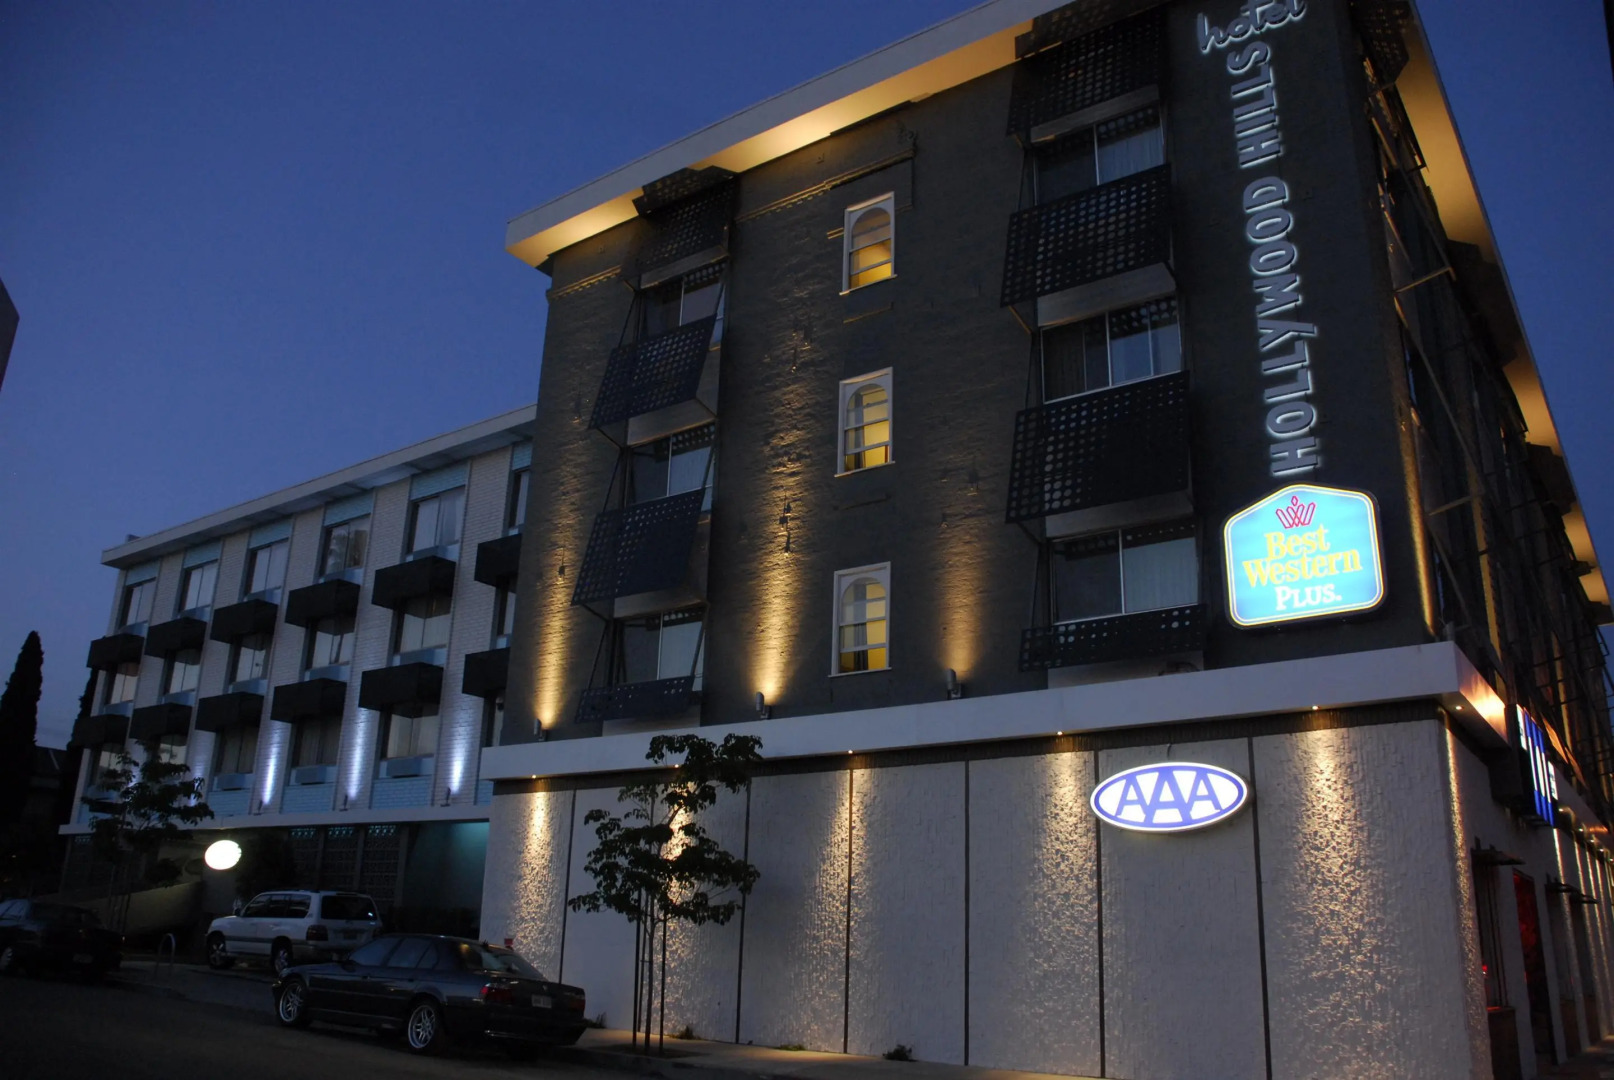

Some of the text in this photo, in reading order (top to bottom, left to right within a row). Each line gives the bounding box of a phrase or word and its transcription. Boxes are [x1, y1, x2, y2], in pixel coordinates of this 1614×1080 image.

[1227, 41, 1318, 476] HOLLYWOOD HILLS
[1264, 524, 1331, 560] Best
[1242, 549, 1363, 588] Western
[1115, 769, 1222, 826] AAA
